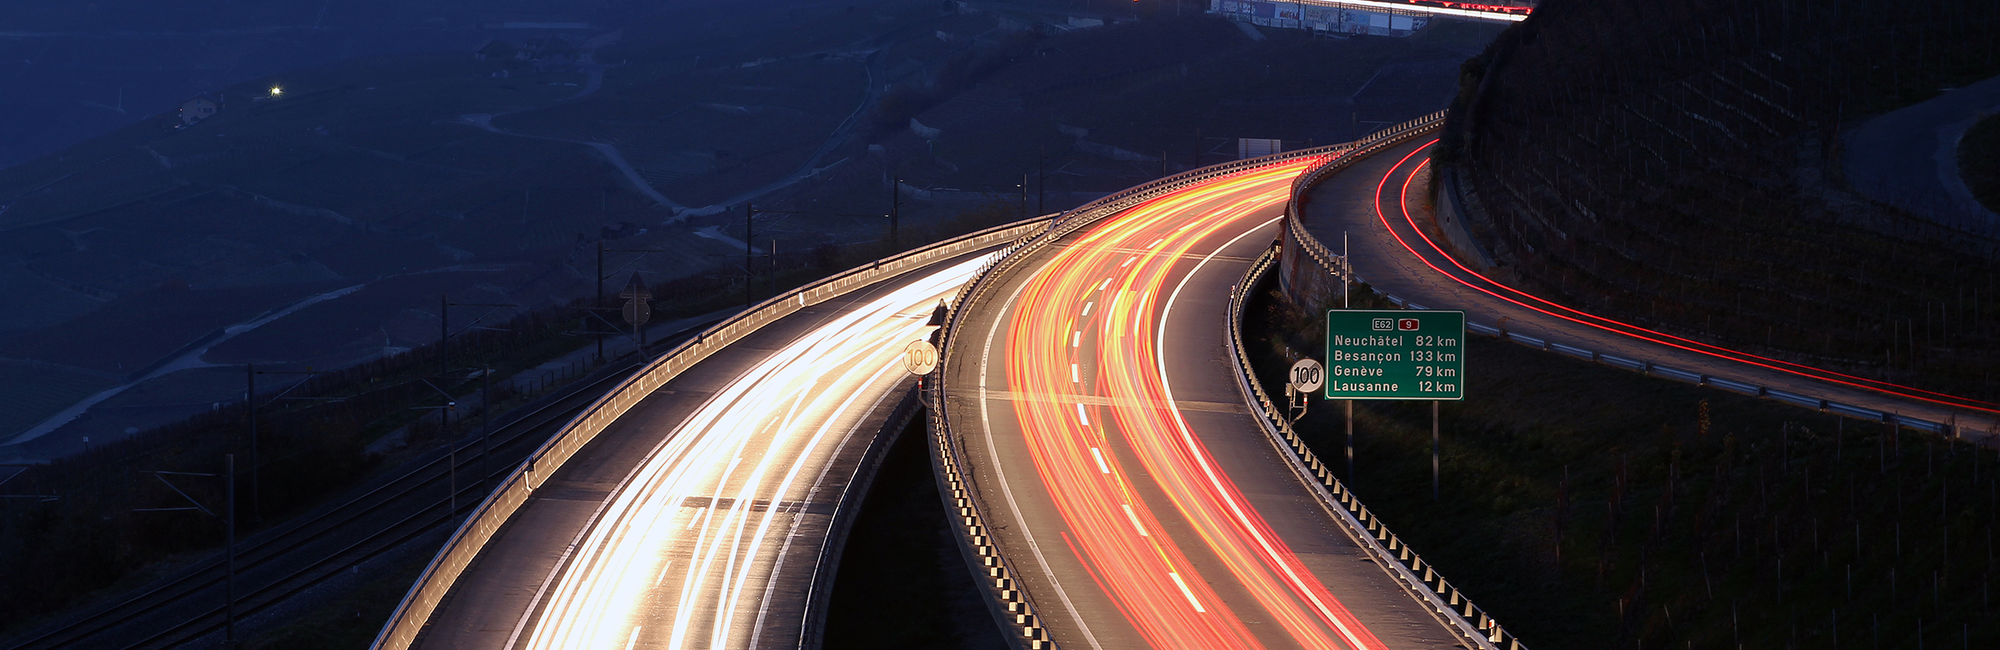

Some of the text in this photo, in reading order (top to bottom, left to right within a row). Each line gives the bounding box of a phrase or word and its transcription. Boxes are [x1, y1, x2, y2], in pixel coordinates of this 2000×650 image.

[1375, 321, 1391, 329] E62
[1405, 321, 1412, 329] 9
[1334, 335, 1456, 347] Neuchâtel 82 km
[908, 349, 933, 366] 100
[1334, 350, 1456, 364] Besançon 133 km
[1294, 366, 1320, 384] 100
[1334, 365, 1456, 377] Genève 79 km
[1334, 381, 1455, 392] Lausanne 12 km
